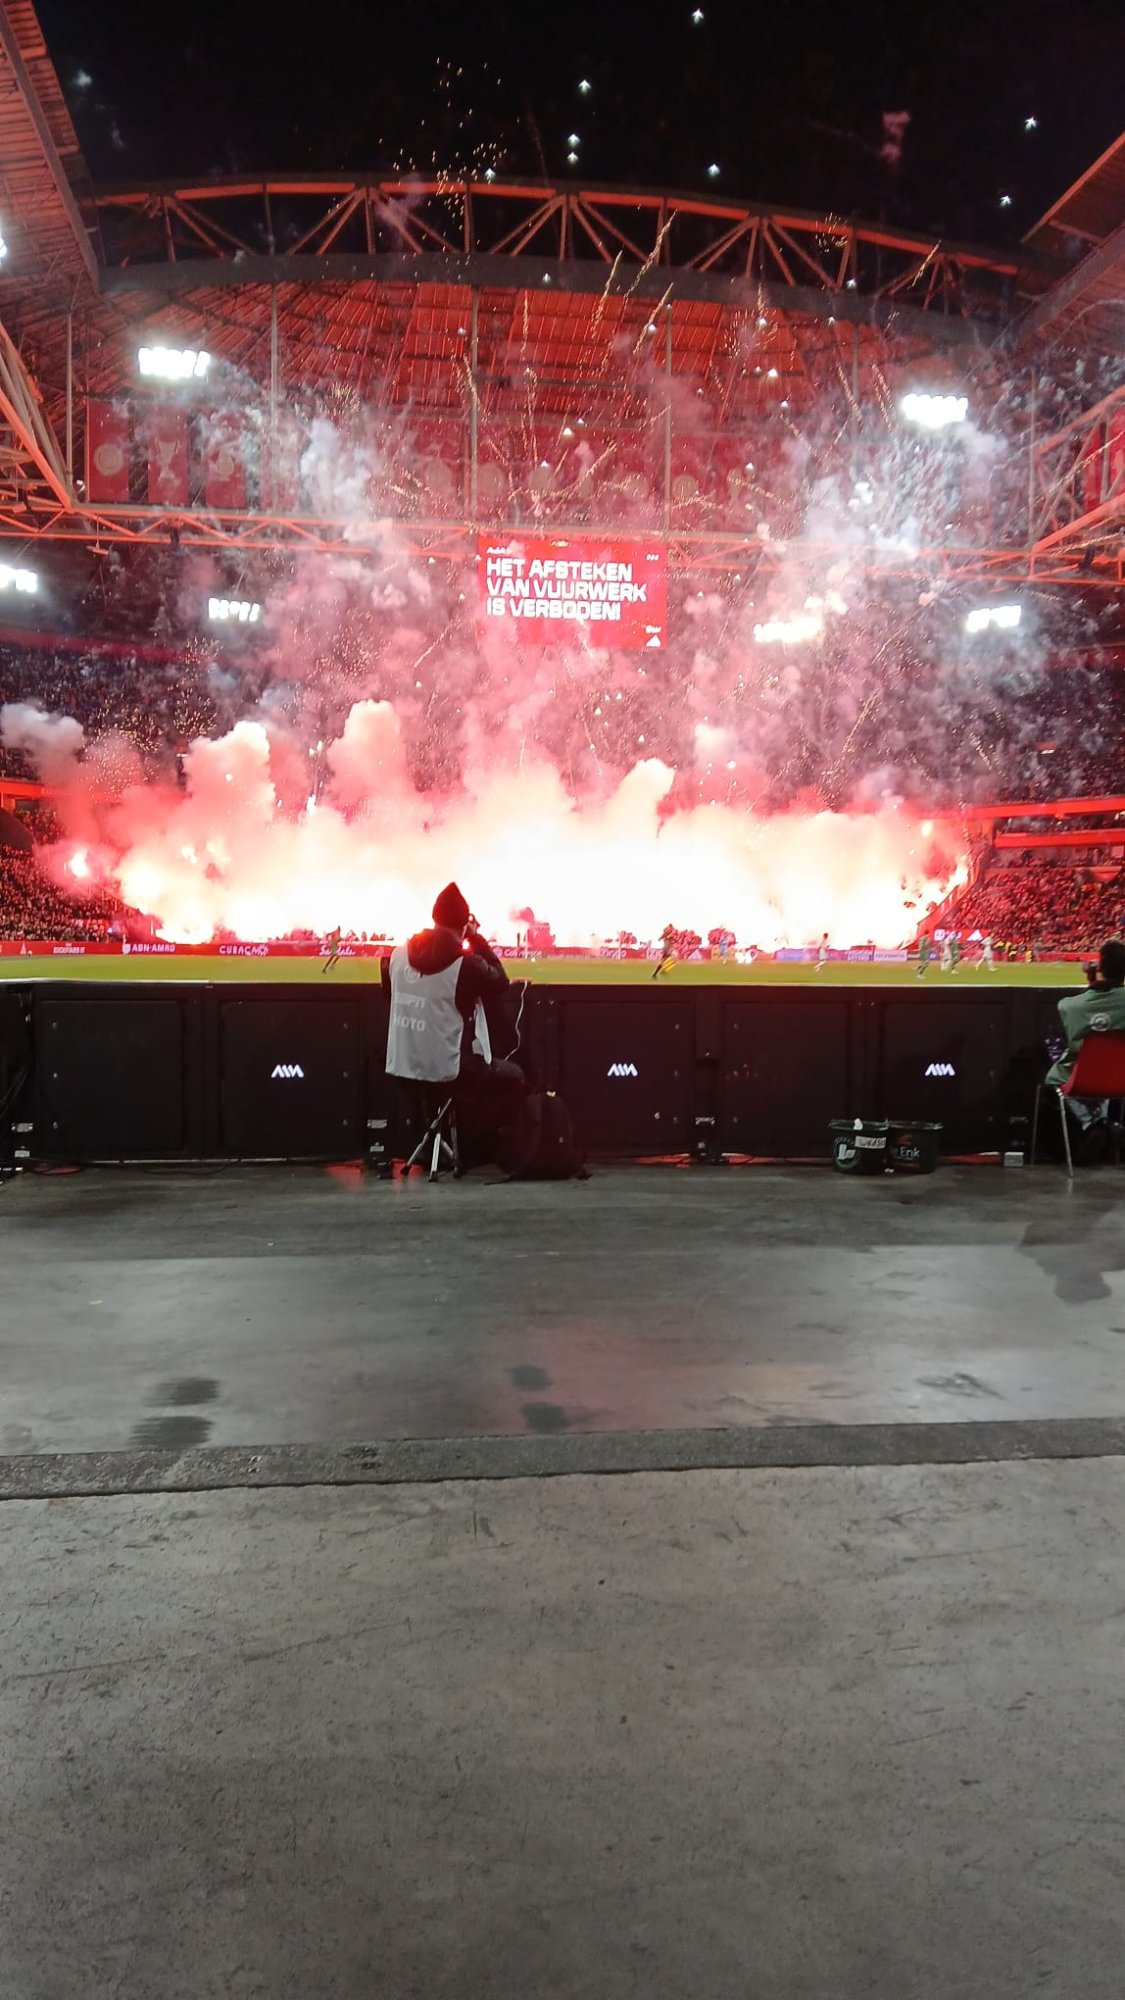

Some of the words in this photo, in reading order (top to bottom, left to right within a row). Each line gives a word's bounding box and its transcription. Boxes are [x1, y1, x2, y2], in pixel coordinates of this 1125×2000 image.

[486, 557, 526, 578] HET
[529, 560, 632, 581] AFSTEKEN
[486, 577, 530, 598] VAN
[534, 580, 647, 602] VUURWERK
[486, 596, 506, 616] IS
